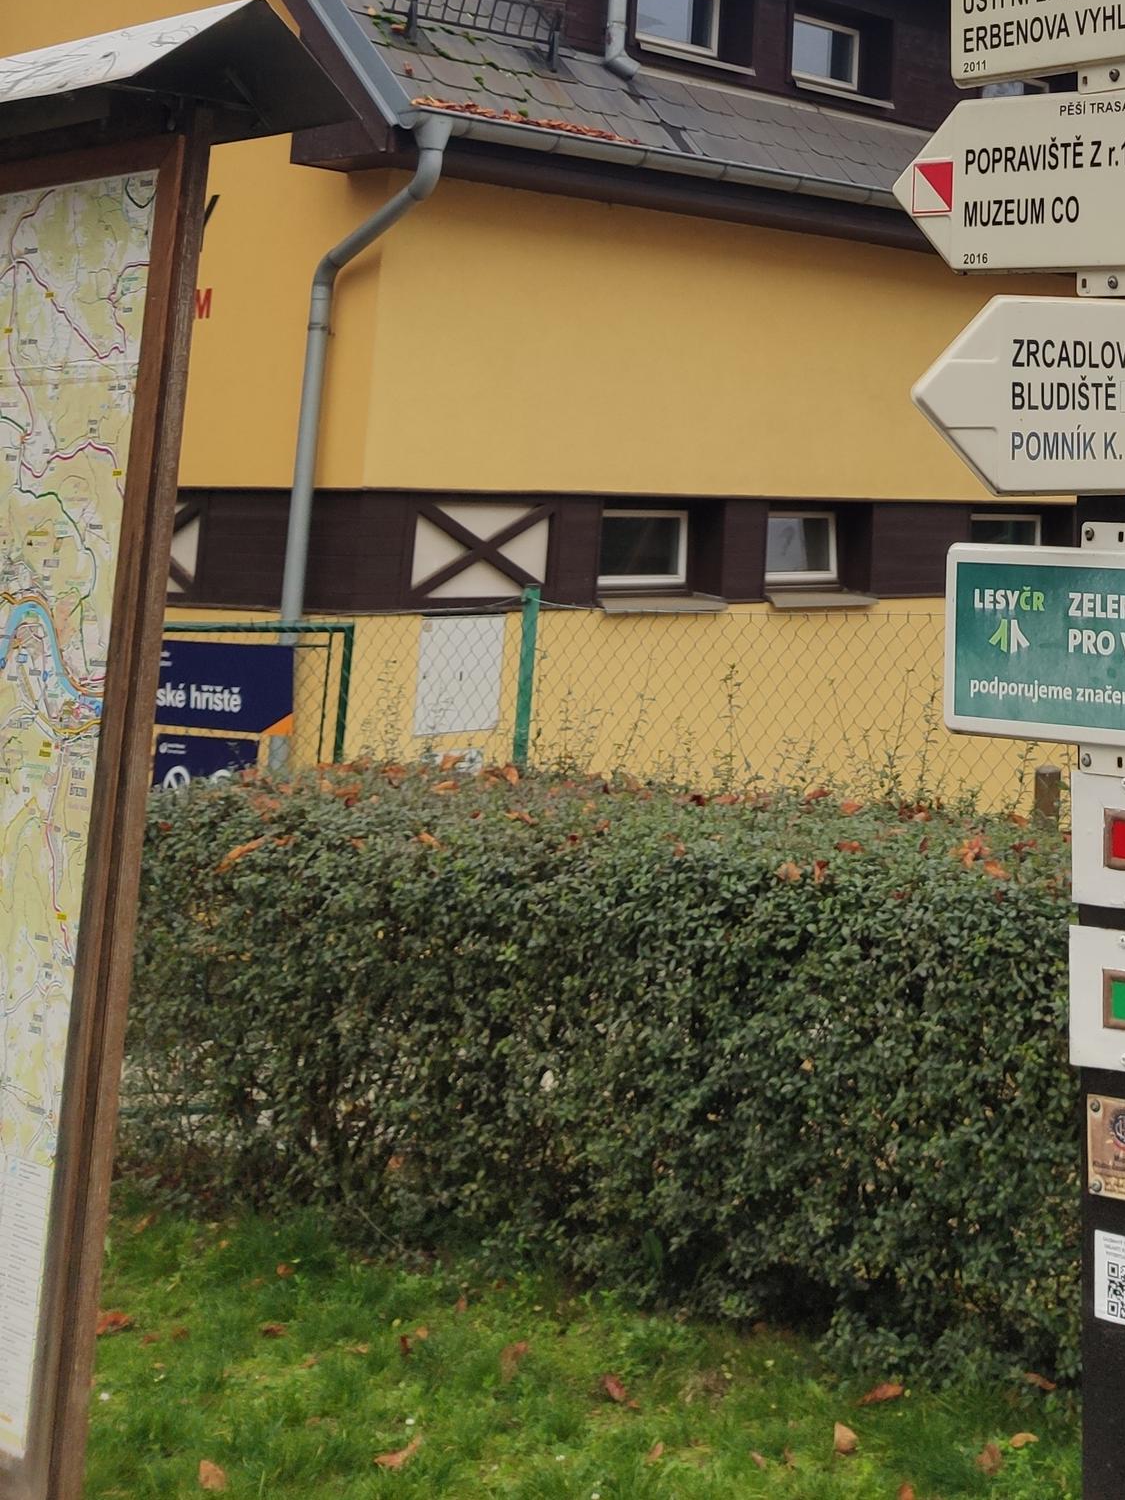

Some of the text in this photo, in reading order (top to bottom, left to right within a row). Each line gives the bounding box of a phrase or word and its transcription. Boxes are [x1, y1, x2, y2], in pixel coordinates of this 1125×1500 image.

[962, 18, 1069, 54] ERBENOVA
[962, 60, 987, 73] 2011
[1059, 101, 1087, 117] PĚŠÍ
[964, 135, 1085, 175] POPRAVIŠTĚ
[1090, 141, 1102, 167] Z
[964, 198, 1046, 228] MUZEUM
[1051, 195, 1080, 224] CO
[963, 253, 988, 265] 2016
[1011, 375, 1117, 411] BLUDIŠTĚ
[1011, 424, 1097, 461] POMNÍK
[1103, 432, 1123, 460] K.
[1068, 628, 1116, 656] PRO
[190, 684, 242, 713] hřiště
[970, 677, 1072, 703] podporujeme
